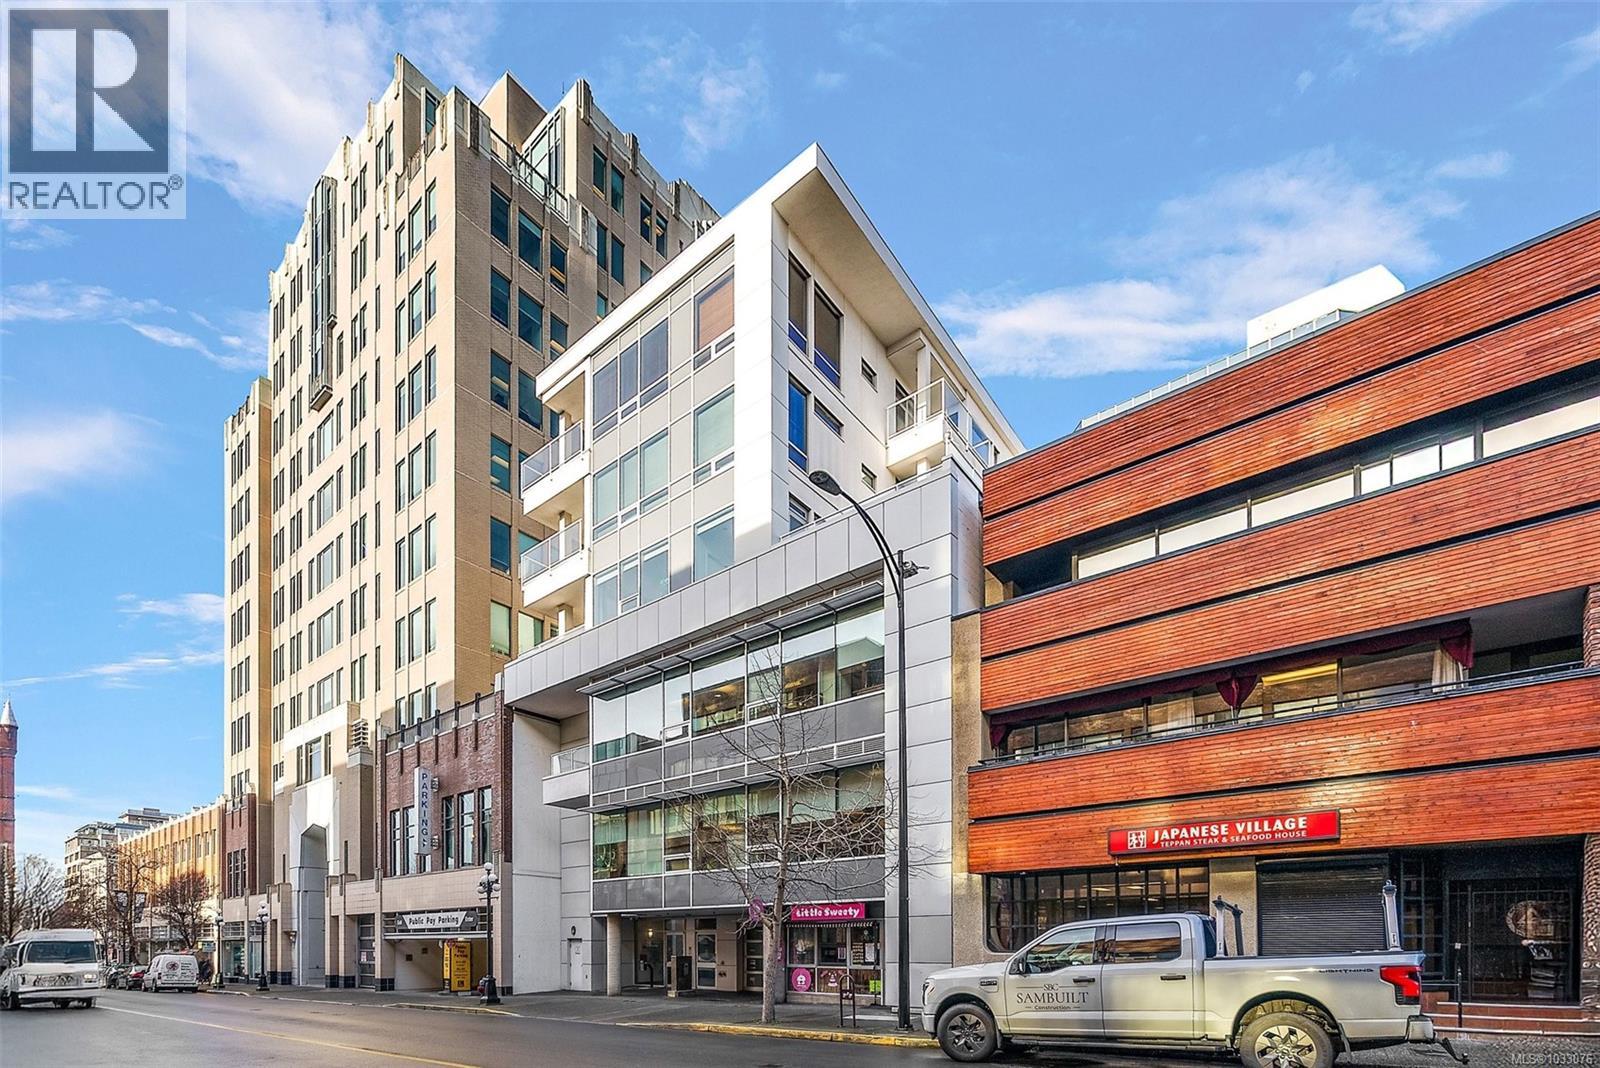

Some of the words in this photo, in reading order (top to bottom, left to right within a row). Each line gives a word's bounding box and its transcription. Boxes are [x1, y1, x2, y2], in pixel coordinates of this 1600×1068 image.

[1153, 824, 1229, 844] JAPANESE
[1235, 816, 1308, 834] VILLAGE
[1160, 840, 1191, 848] TEPPAN
[1193, 837, 1219, 845] STEAK
[1230, 833, 1272, 843] SEAFOOD
[1274, 830, 1307, 839] HOUSE
[796, 908, 823, 917] Little
[824, 907, 860, 918] Sweety
[408, 917, 424, 925] Public
[426, 916, 436, 926] Pay
[437, 915, 459, 925] Parking
[1016, 992, 1089, 1004] SAMBUILT
